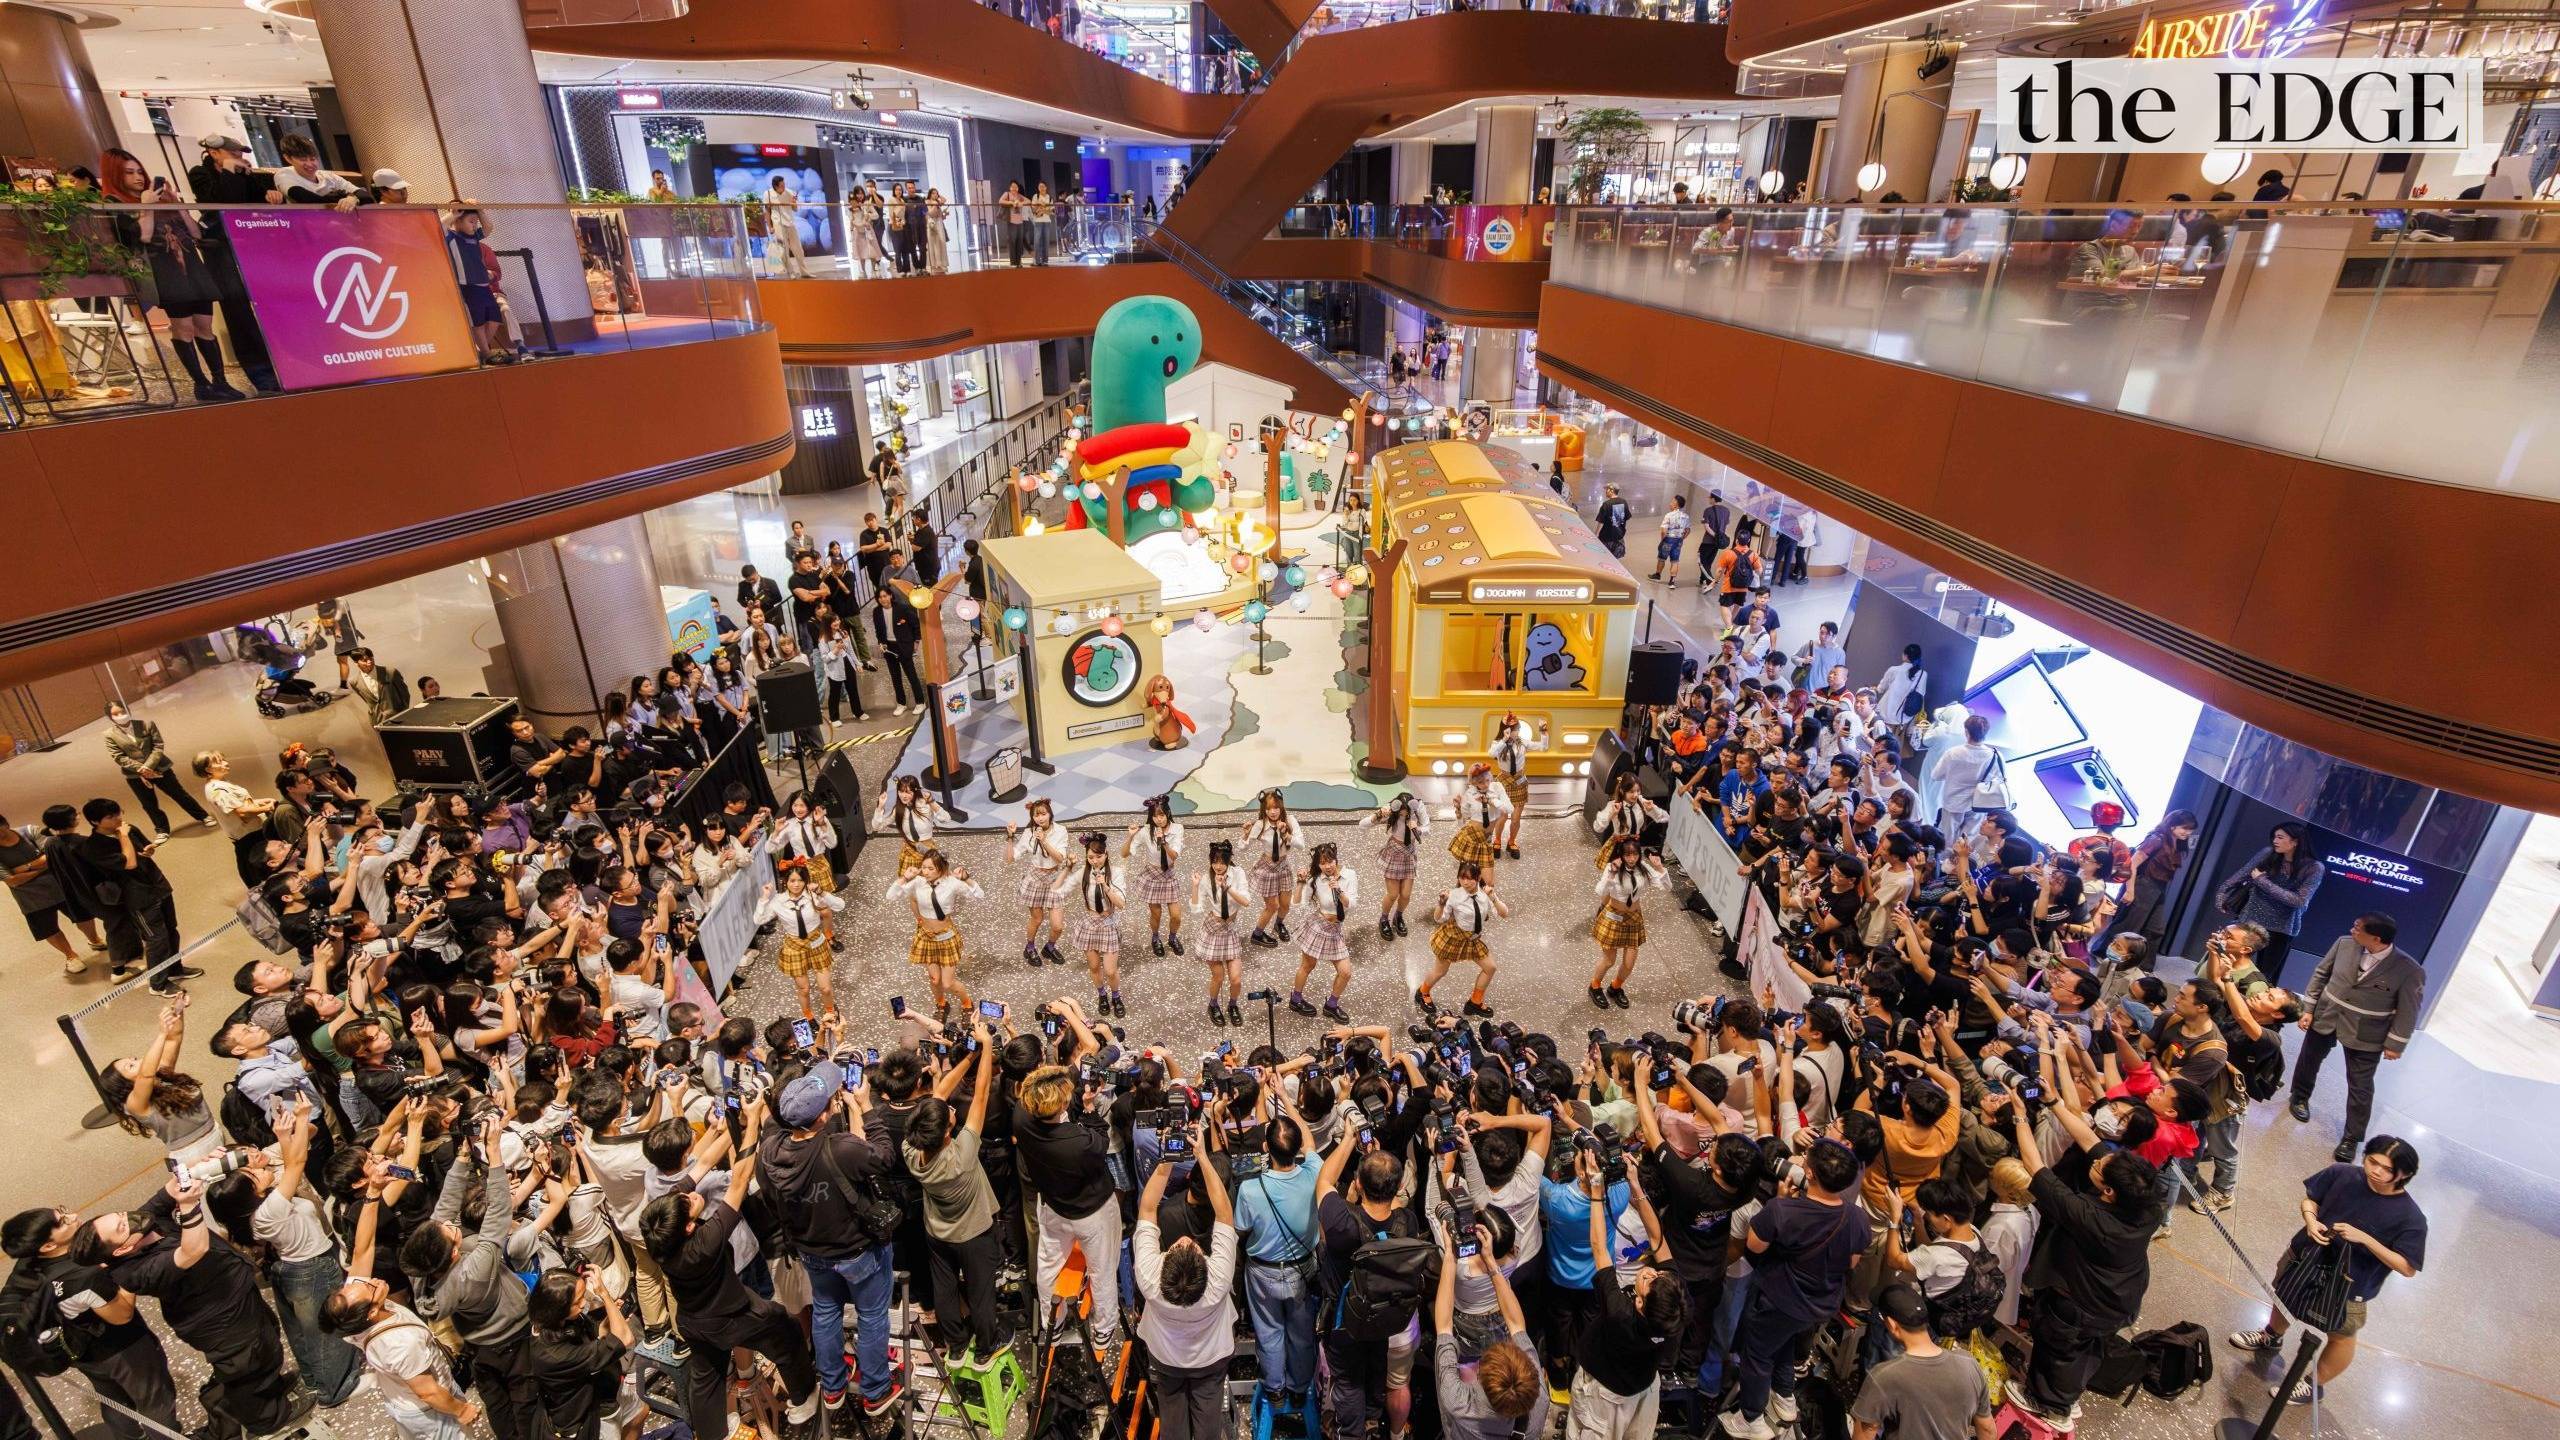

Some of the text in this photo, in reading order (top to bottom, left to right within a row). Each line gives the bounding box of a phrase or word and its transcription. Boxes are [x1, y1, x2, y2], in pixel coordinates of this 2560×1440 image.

[2132, 4, 2276, 62] AIRSIDE
[834, 91, 845, 109] 3
[235, 218, 290, 229] Organised by
[324, 343, 437, 366] GOLDNOW CULTURE
[1486, 588, 1577, 598] JOGUMAN AIRSIDE
[2326, 855, 2374, 874] DEMON
[2375, 867, 2424, 885] HUNTERS
[2347, 852, 2410, 872] KPOP
